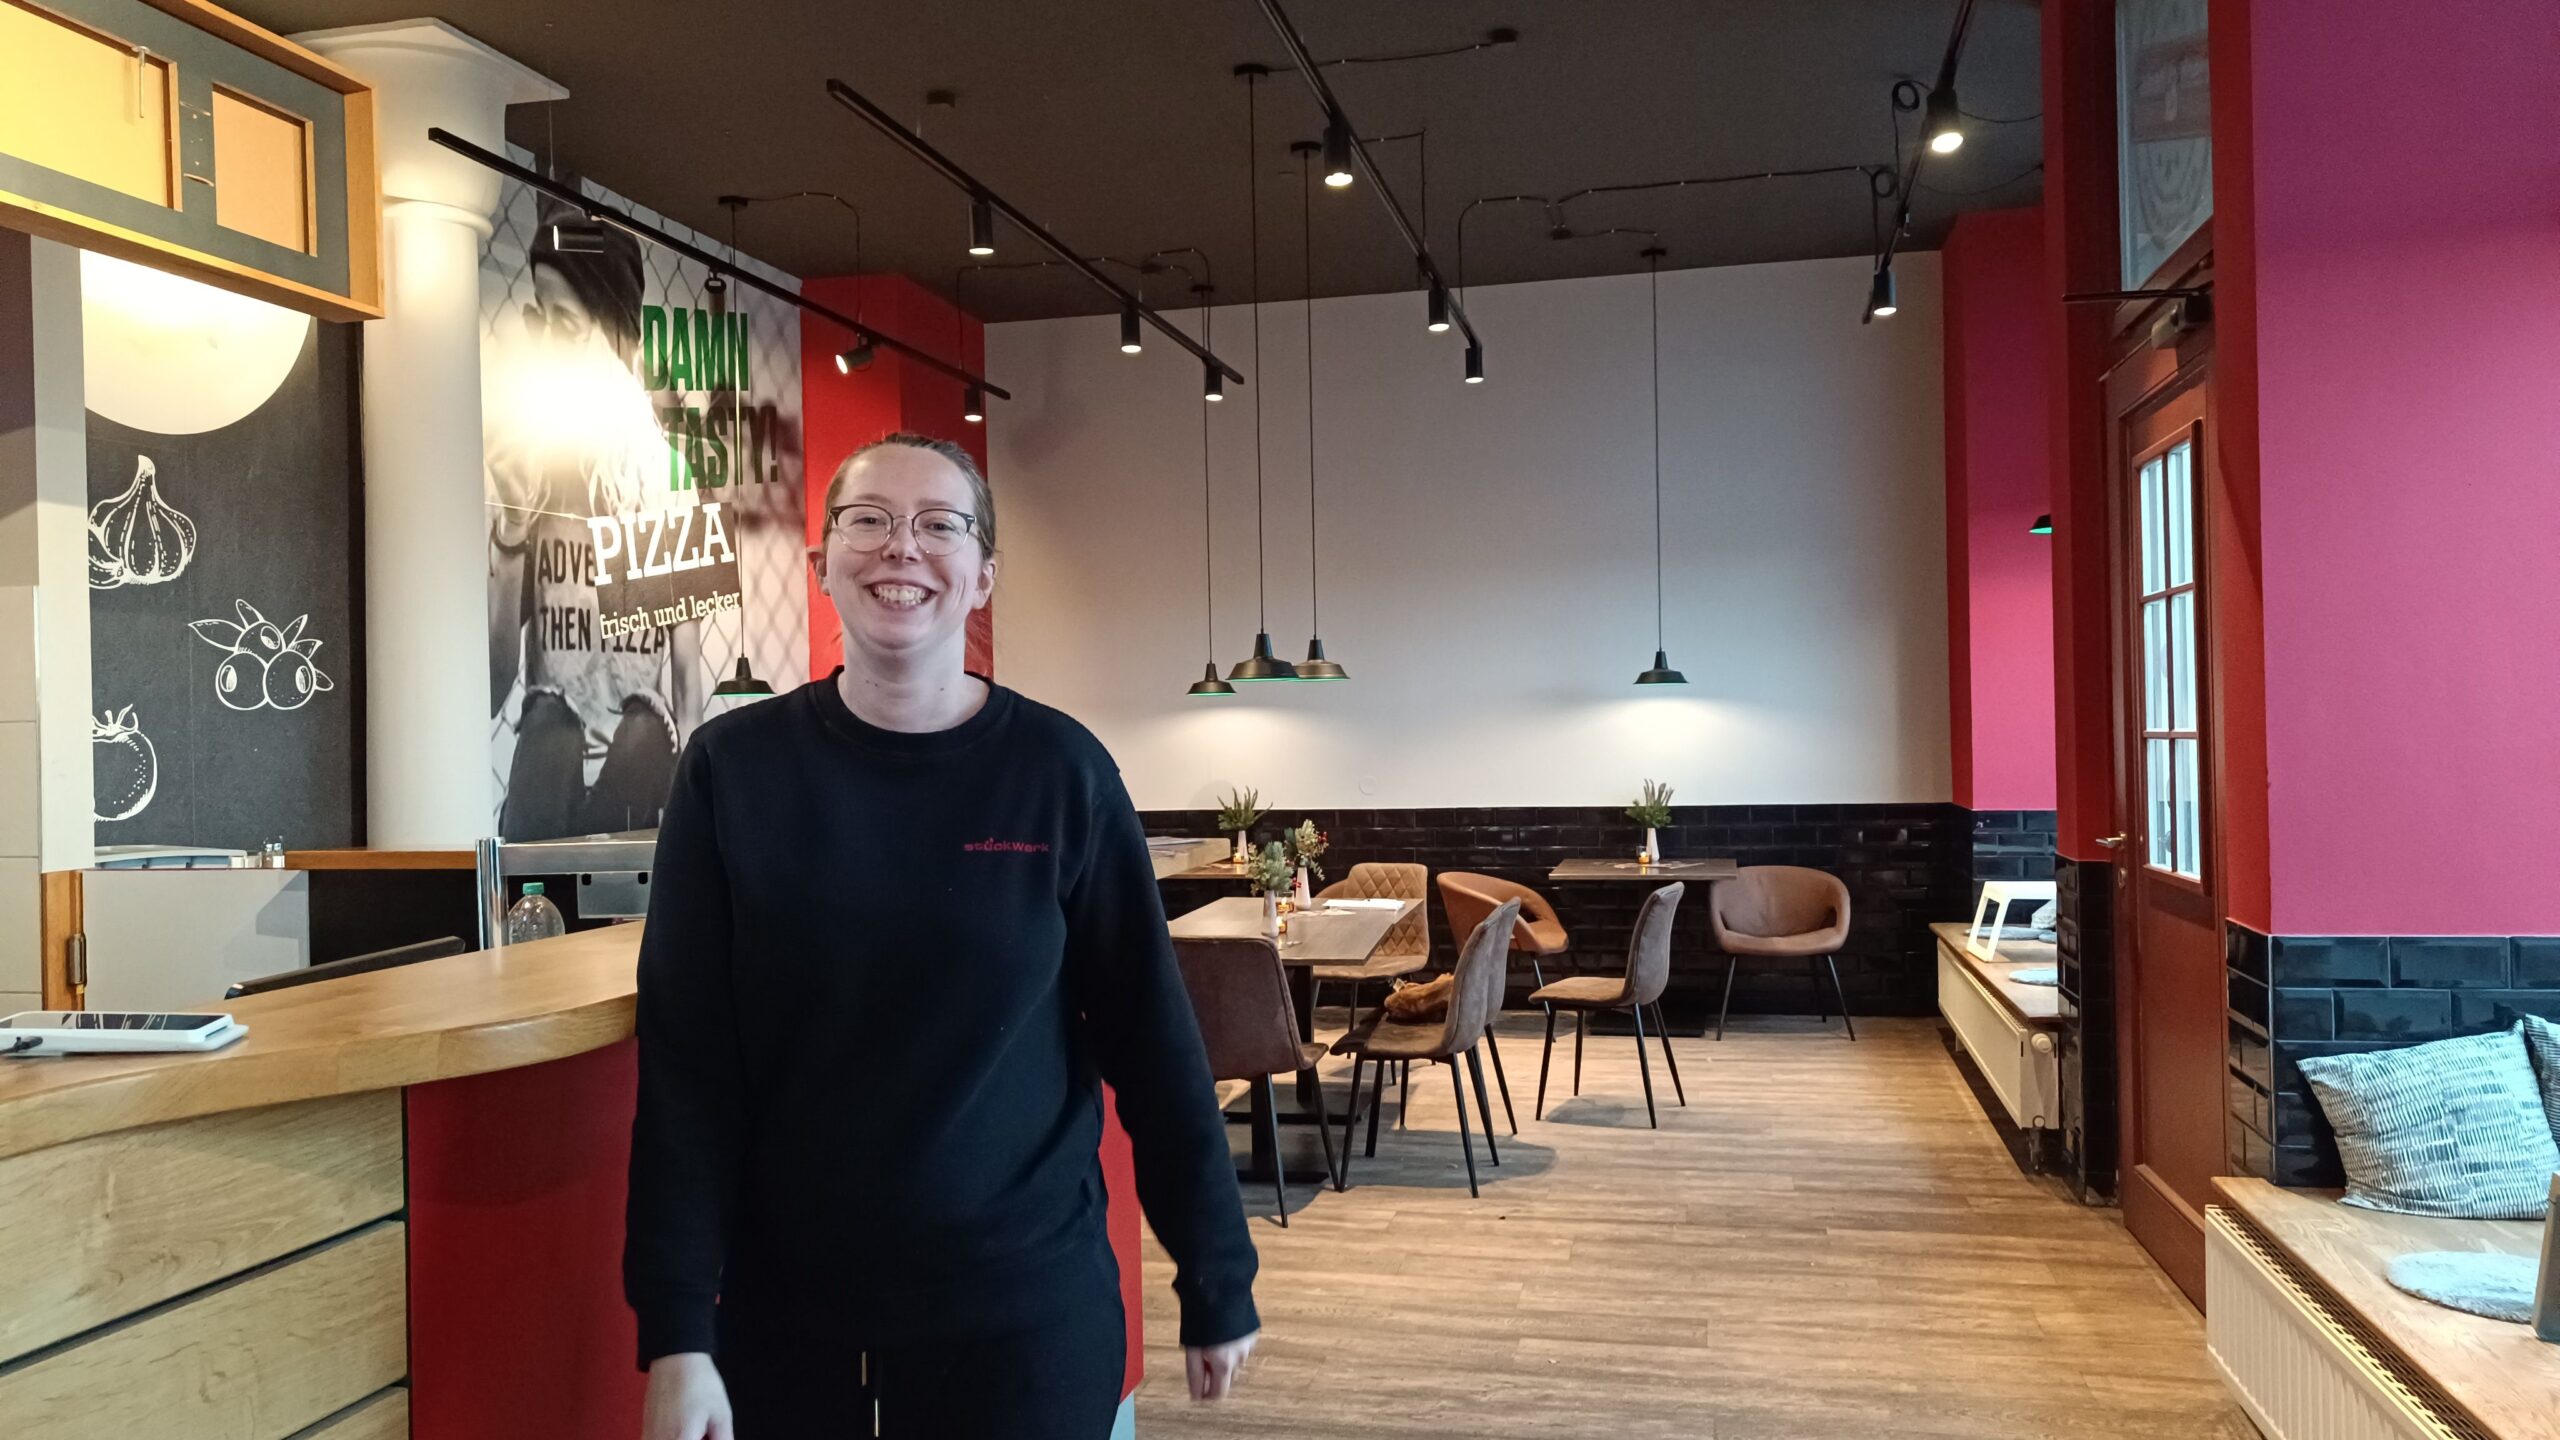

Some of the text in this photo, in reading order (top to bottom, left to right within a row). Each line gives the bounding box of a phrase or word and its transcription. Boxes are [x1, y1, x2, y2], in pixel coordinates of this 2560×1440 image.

[643, 305, 749, 391] DAMN
[662, 406, 778, 491] TASTY!
[587, 502, 735, 586] PIZZA
[540, 605, 591, 652] THEN
[599, 590, 741, 640] frisch und lecker
